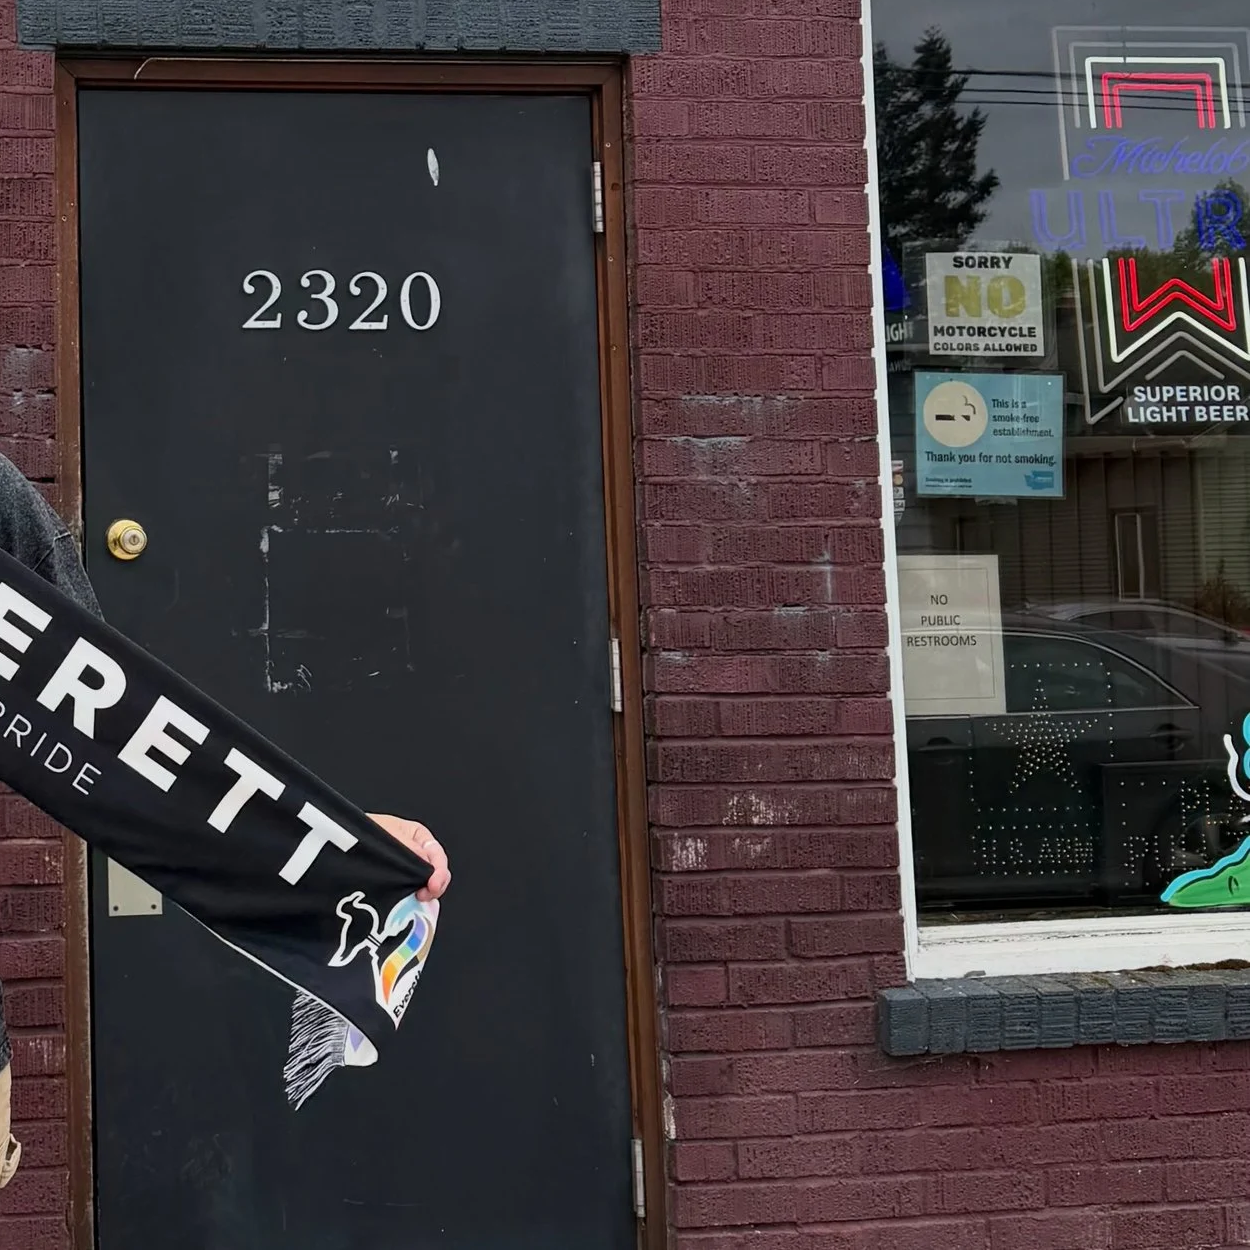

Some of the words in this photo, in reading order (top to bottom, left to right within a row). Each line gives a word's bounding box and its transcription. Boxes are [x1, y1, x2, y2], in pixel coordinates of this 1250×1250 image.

[1070, 135, 1250, 179] Michelob
[1029, 188, 1248, 251] ULTR
[952, 256, 1013, 269] SORRY
[242, 269, 441, 331] 2320
[944, 275, 1027, 319] NO
[885, 319, 914, 342] IGHT
[933, 325, 1037, 338] MOTORCYCLE
[933, 342, 981, 352] COLORS
[983, 343, 1038, 353] ALLOWED
[1133, 385, 1241, 402] SUPERIOR
[991, 399, 1010, 409] This
[1011, 399, 1019, 409] is
[992, 413, 1040, 423] smoke-free
[1127, 406, 1190, 422] LIGHT
[1194, 405, 1250, 422] BEER
[925, 450, 958, 463] Thank
[958, 453, 976, 465] you
[978, 452, 994, 463] for
[995, 452, 1012, 463] not
[1014, 453, 1057, 467] smoking.
[930, 594, 948, 605] NO
[920, 614, 961, 626] PUBLIC
[906, 635, 977, 647] RESTROOMS
